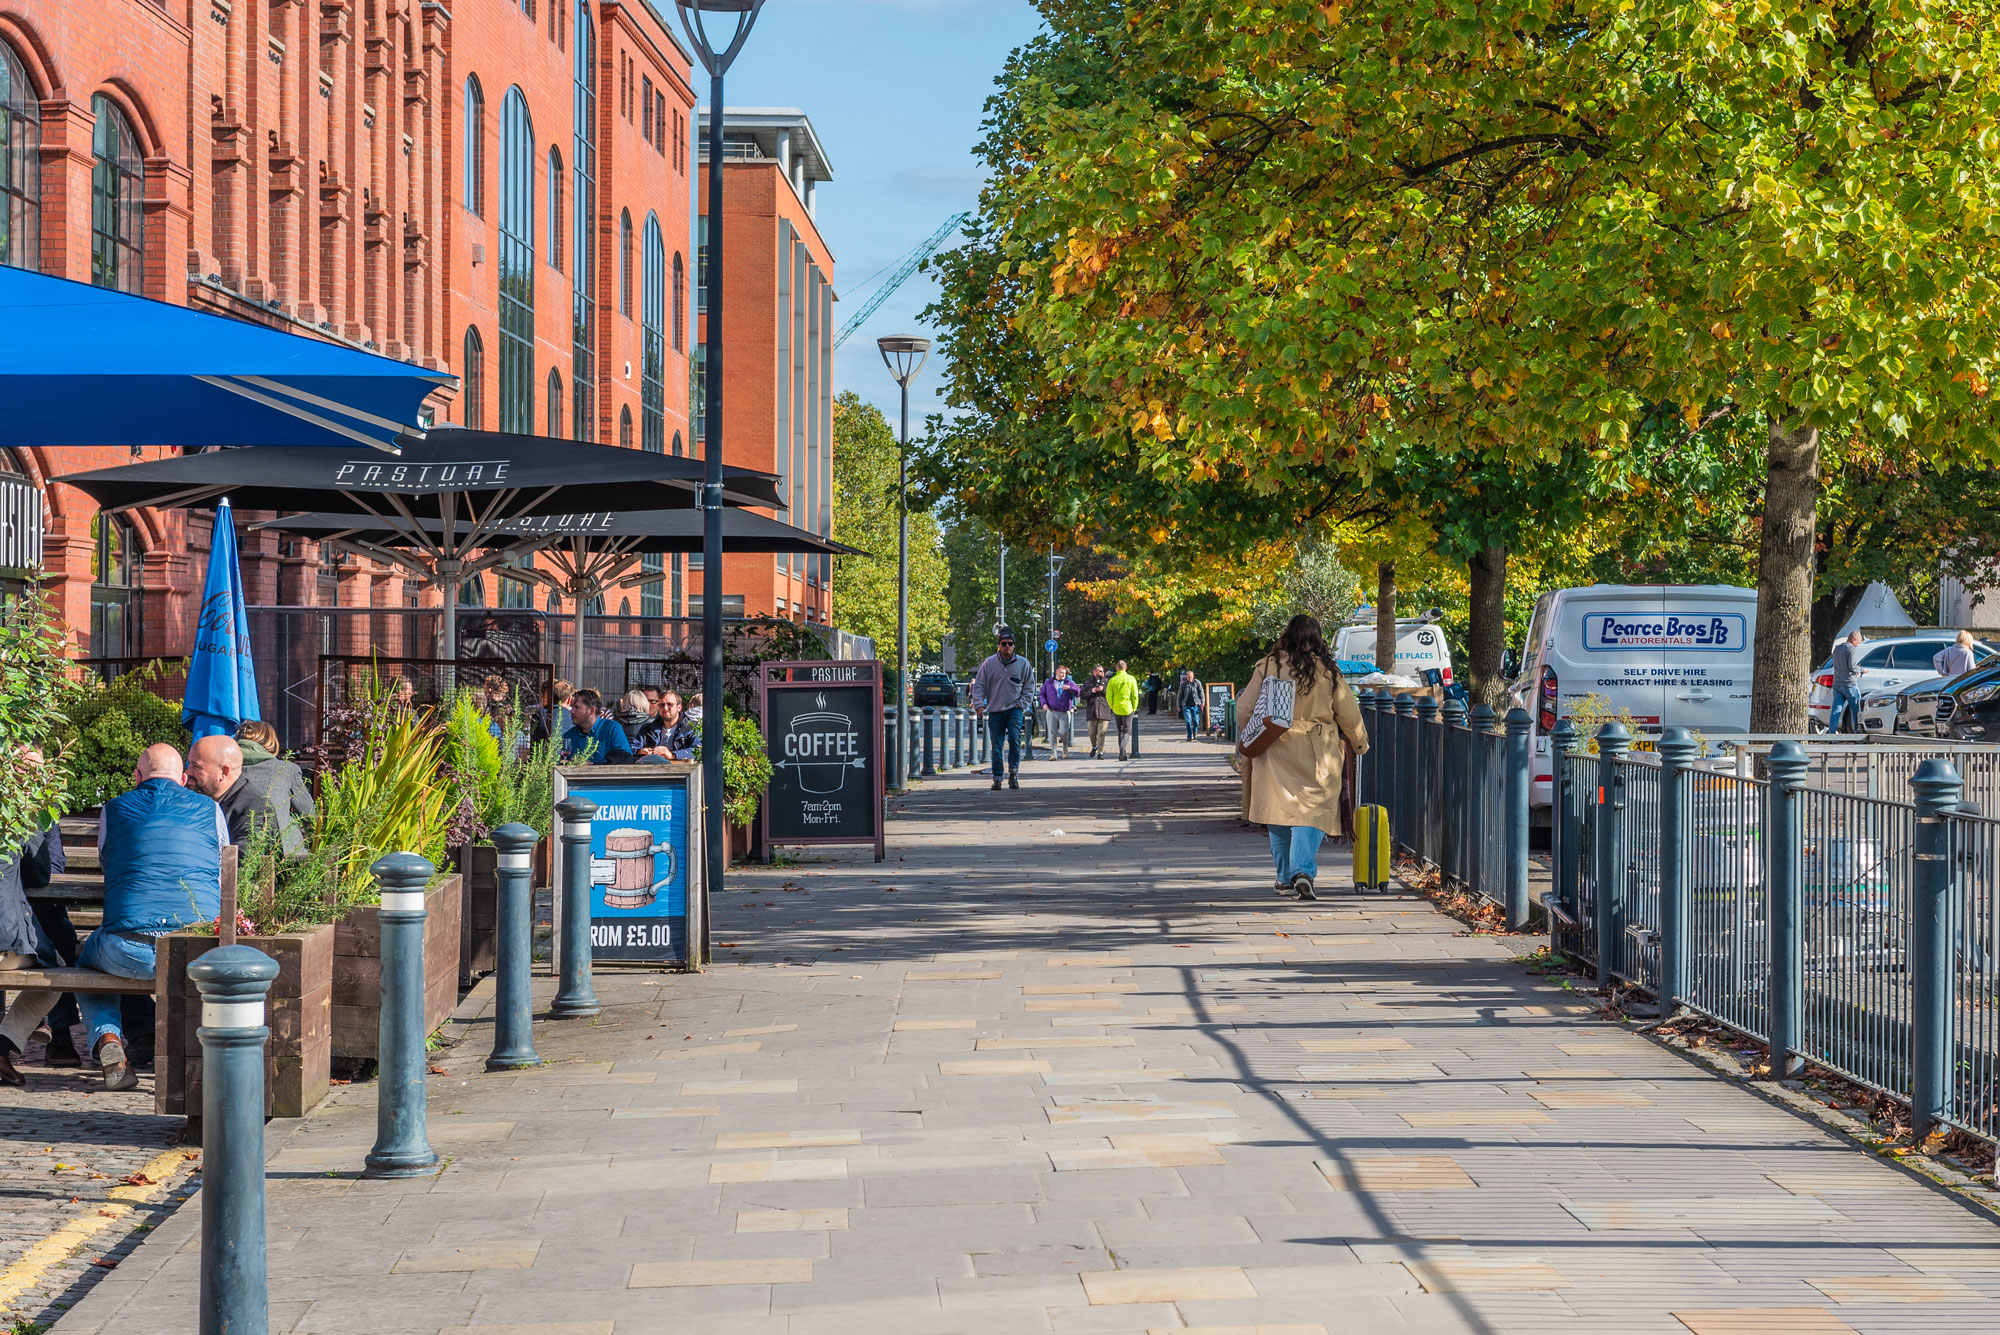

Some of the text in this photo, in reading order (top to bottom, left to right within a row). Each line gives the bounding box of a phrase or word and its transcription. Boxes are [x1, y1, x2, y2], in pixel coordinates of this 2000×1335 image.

[335, 464, 511, 482] PASTURE
[0, 481, 46, 571] ASTURE
[1601, 617, 1664, 638] Pearce
[1666, 617, 1707, 637] Bros
[1620, 637, 1693, 645] AUTORENTALS
[197, 641, 237, 659] UGAR
[1394, 652, 1404, 660] KE
[1405, 652, 1434, 660] PLACES
[811, 666, 857, 682] PASTURE
[1624, 668, 1707, 676] SELF DRIVE HIRE
[1597, 678, 1651, 687] CONTRACT
[1690, 679, 1734, 687] LEASING
[784, 732, 859, 757] COFFEE
[641, 804, 672, 821] PINTS
[801, 800, 842, 814] 7am-2pm
[590, 924, 671, 947] ROM £5.00
